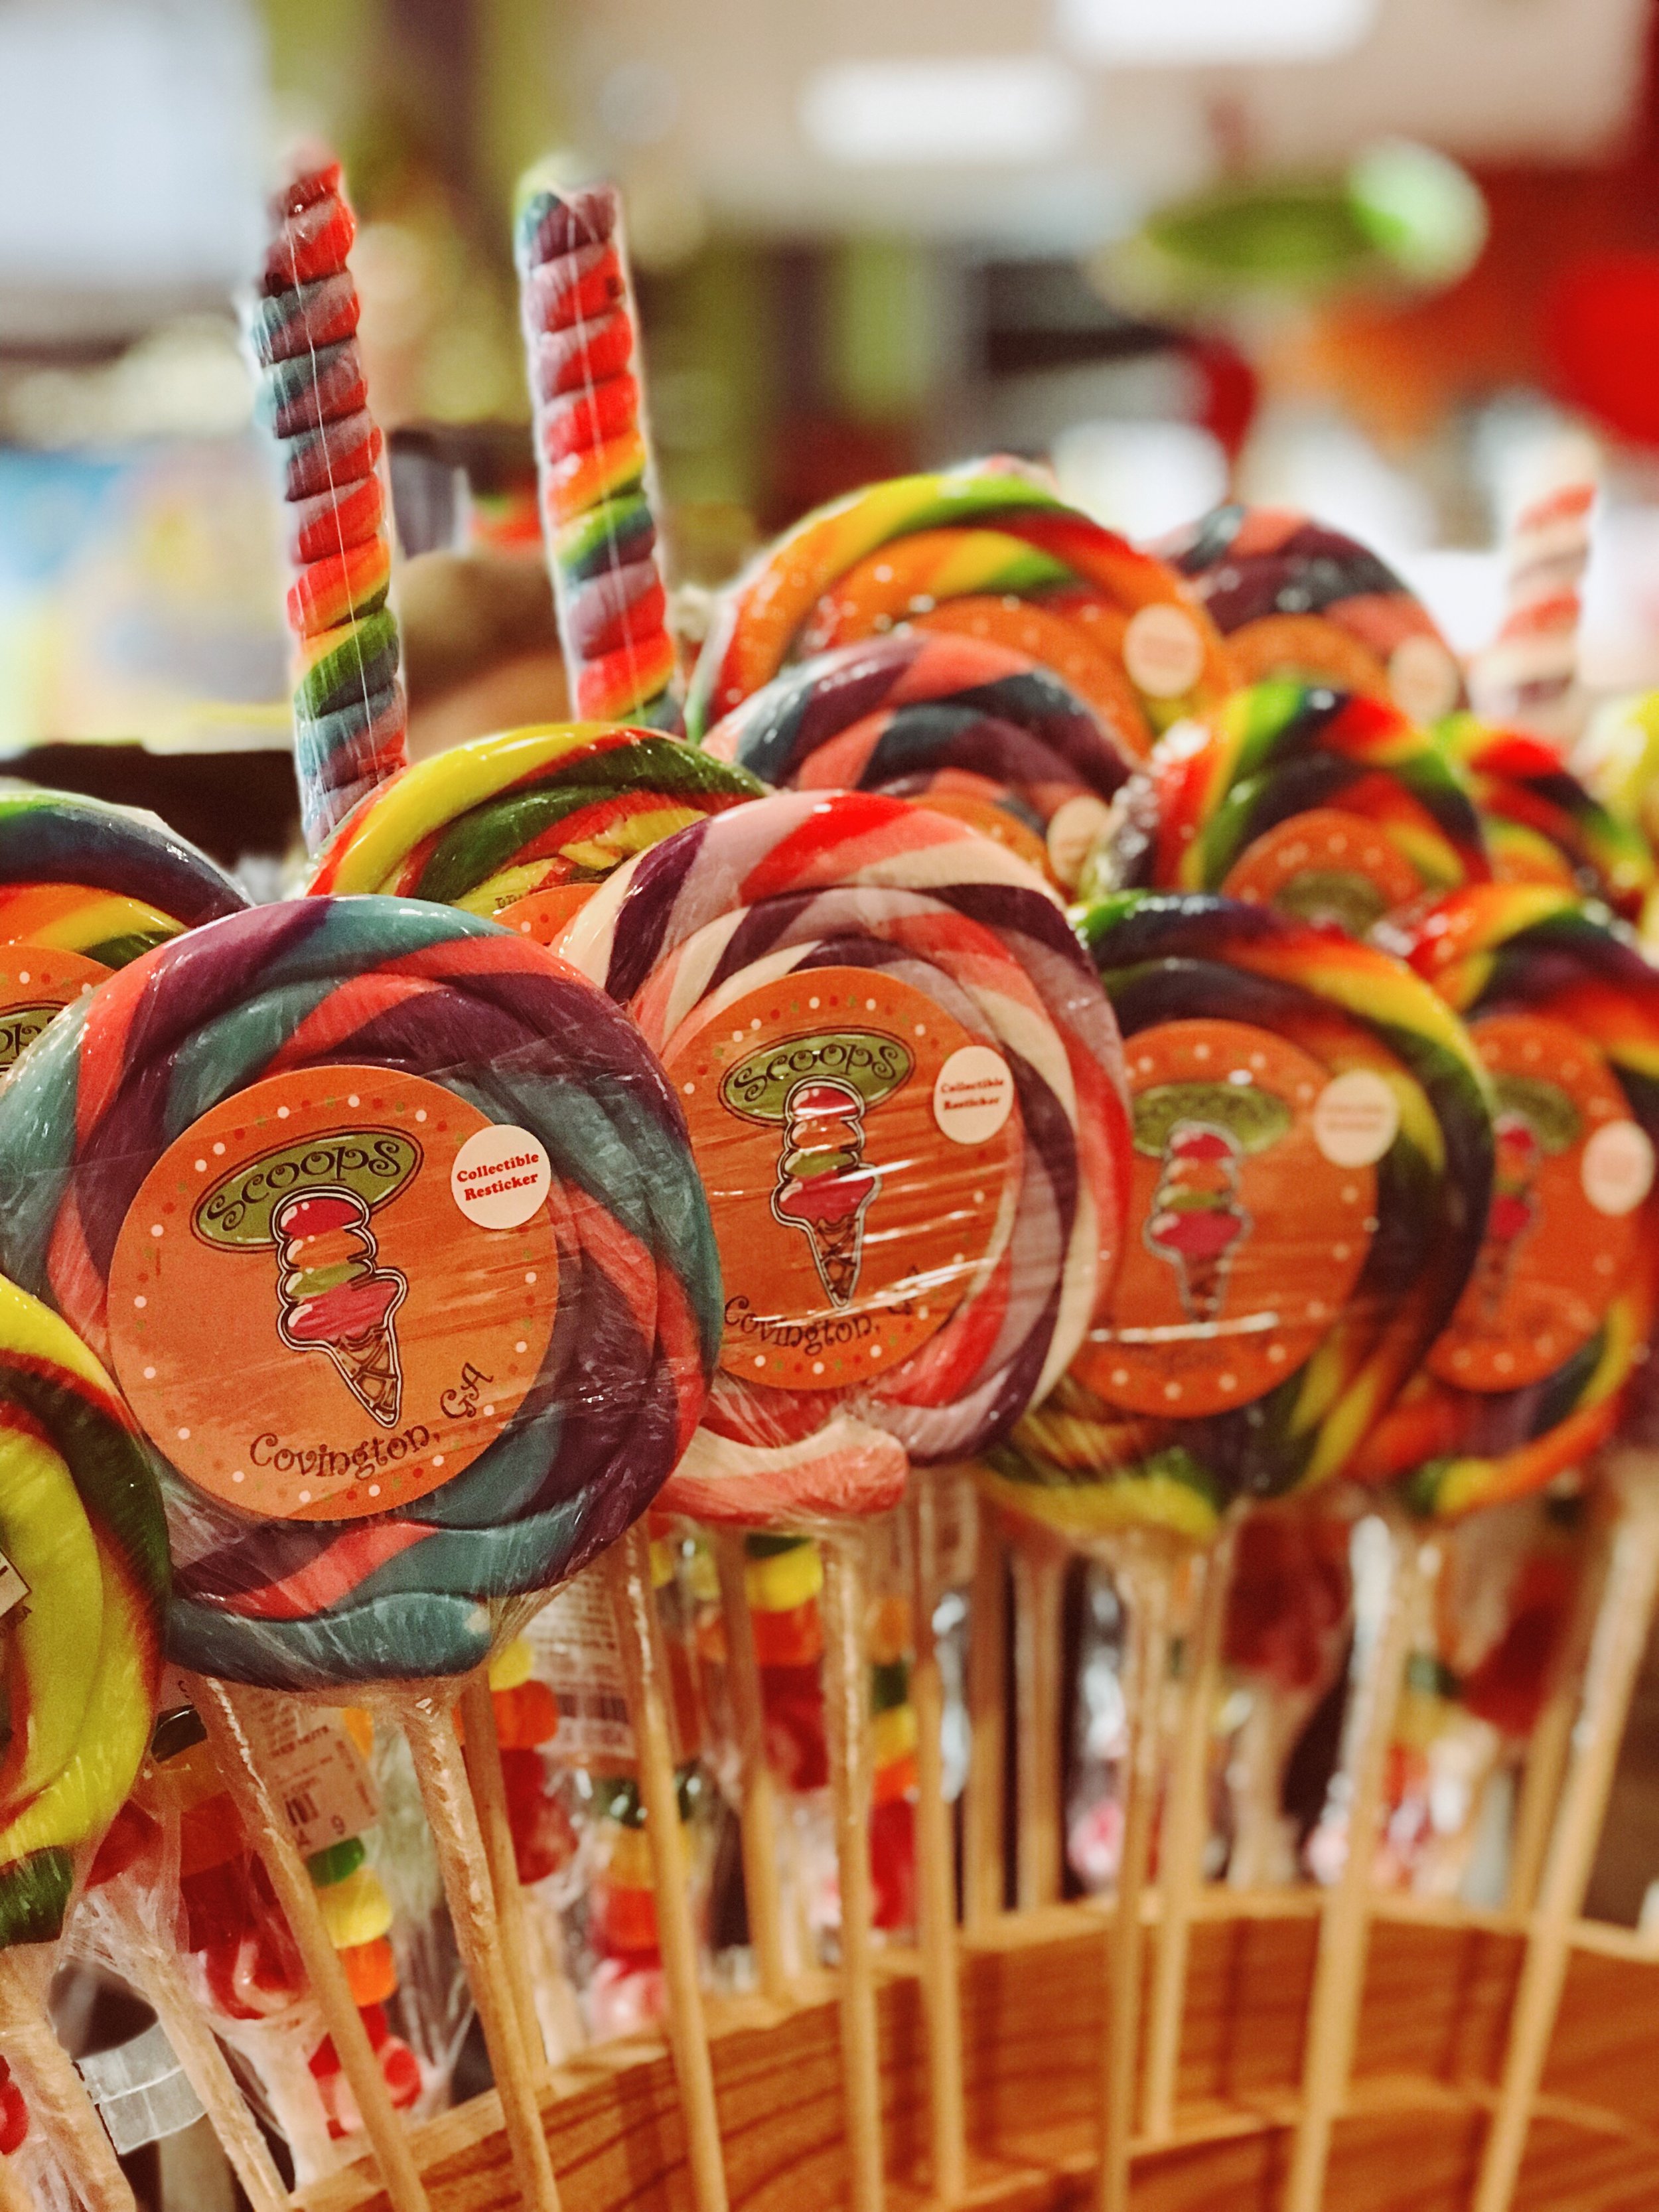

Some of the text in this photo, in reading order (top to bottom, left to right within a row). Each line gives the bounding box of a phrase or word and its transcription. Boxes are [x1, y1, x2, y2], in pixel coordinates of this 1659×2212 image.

[457, 1153, 540, 1183] Collectible
[464, 1173, 538, 1201] Resticker
[250, 1362, 494, 1481] Covington, GA
